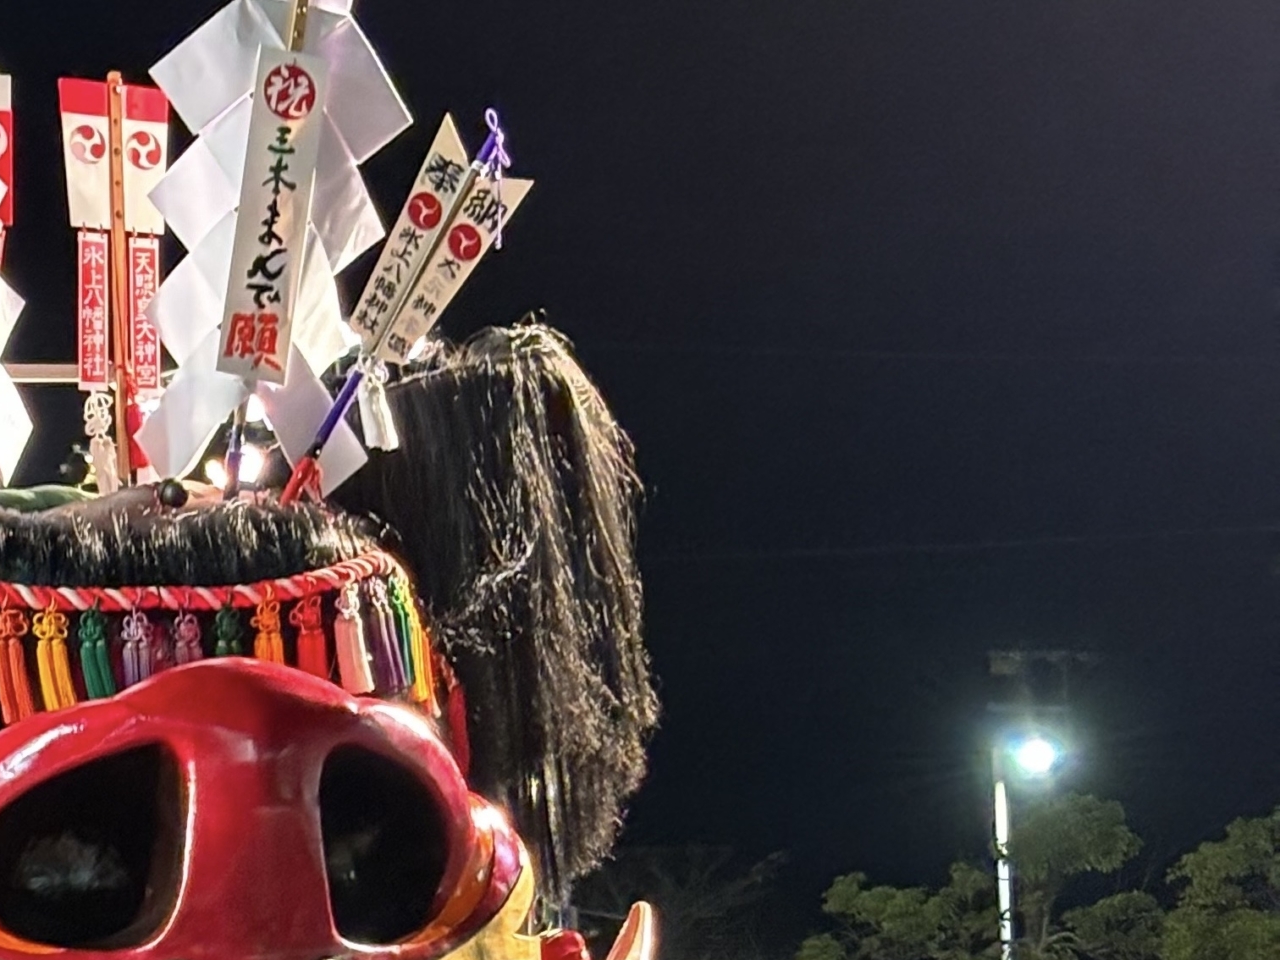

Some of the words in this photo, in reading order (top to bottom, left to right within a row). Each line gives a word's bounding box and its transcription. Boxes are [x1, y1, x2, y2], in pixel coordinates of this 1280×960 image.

[266, 60, 312, 117] 祝
[424, 153, 466, 194] 奉
[462, 188, 508, 235] 納
[81, 245, 105, 377] 氷上八幡神社
